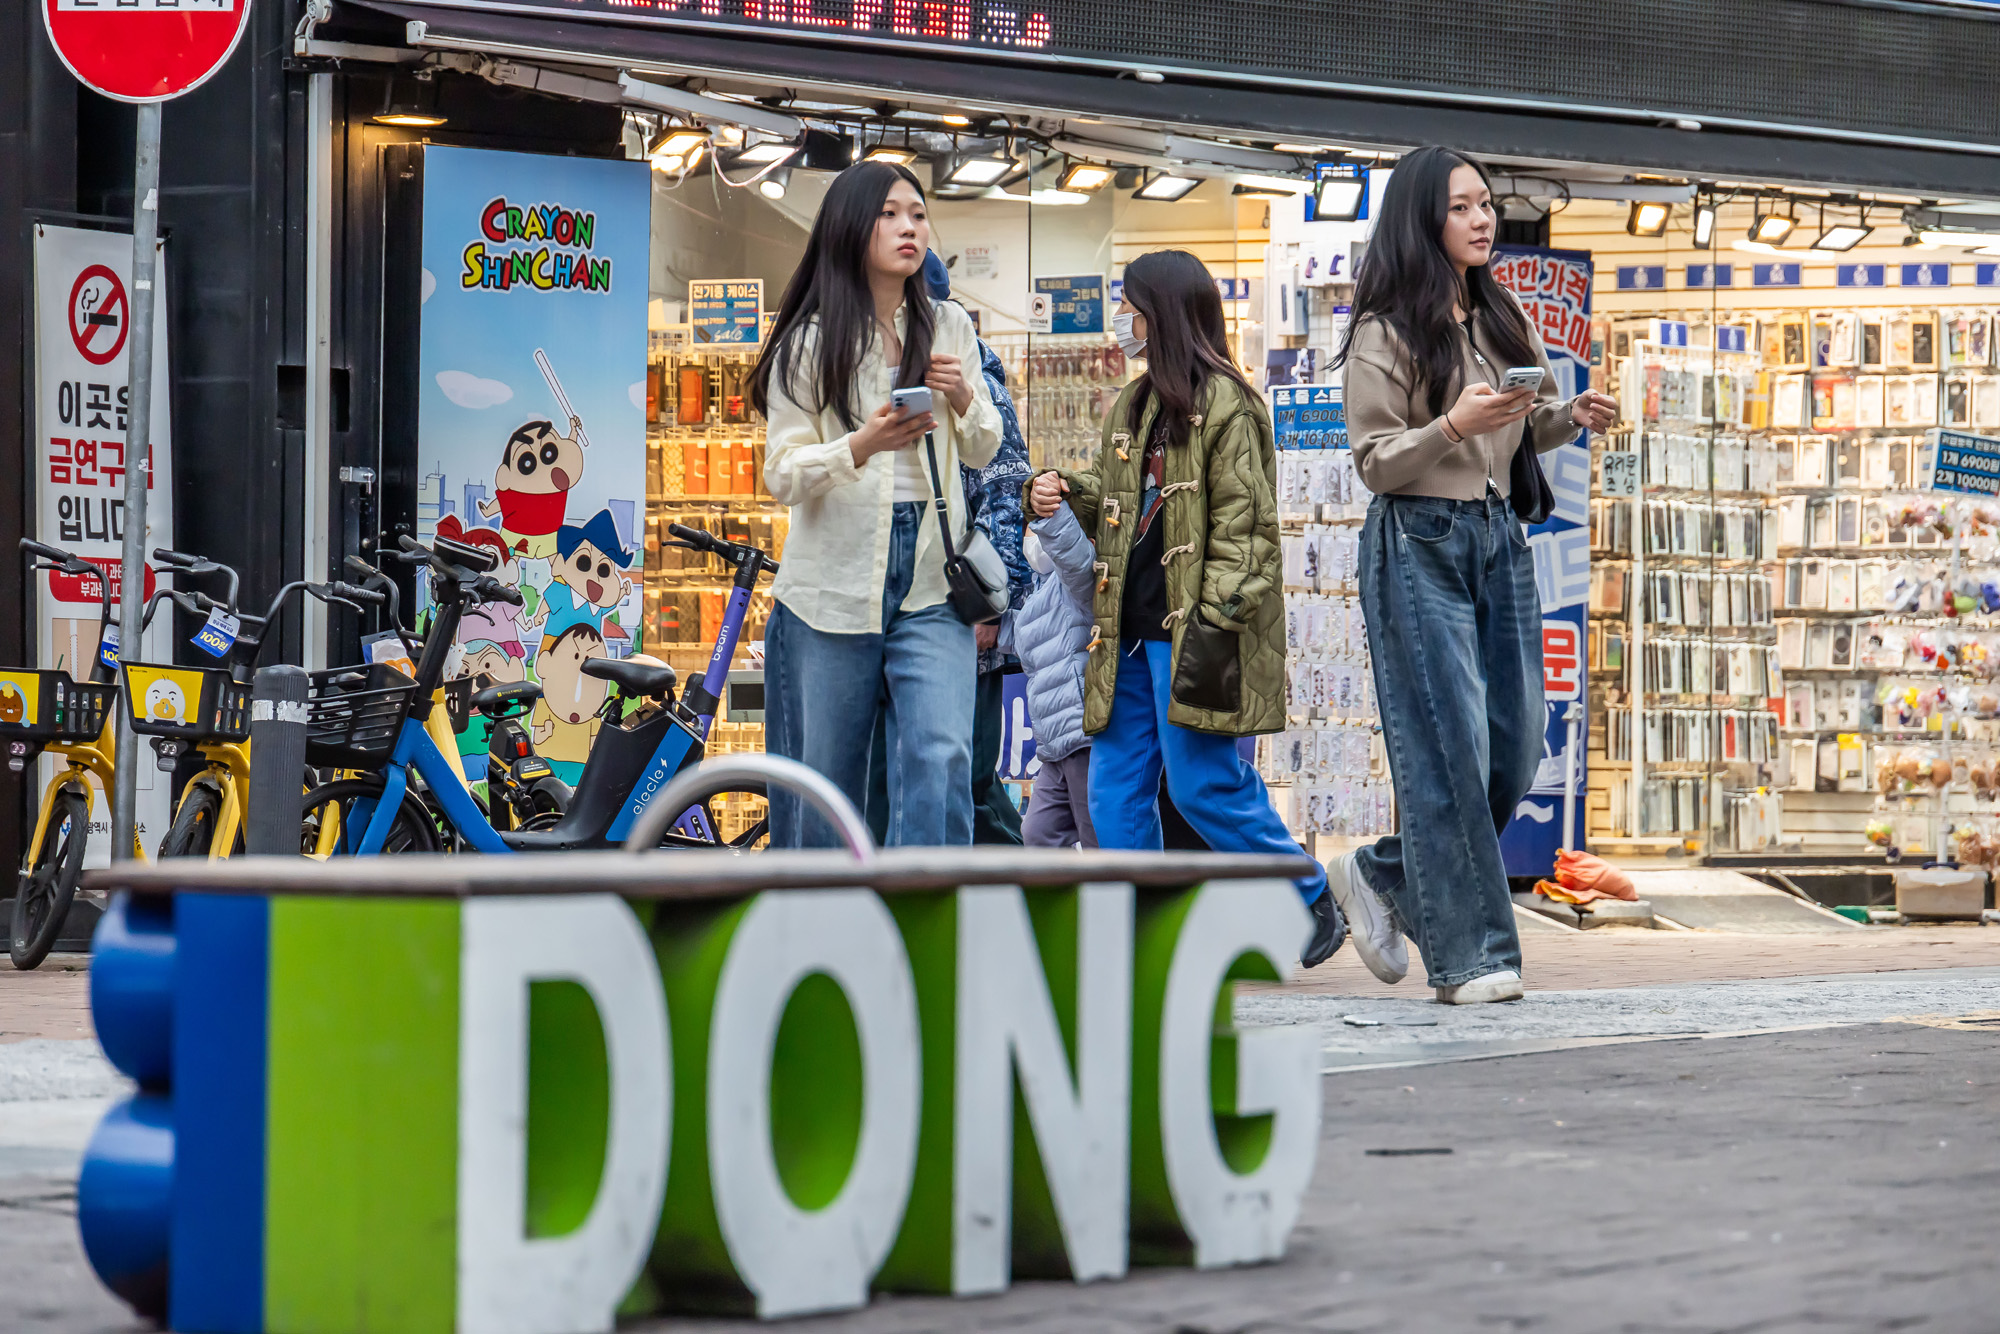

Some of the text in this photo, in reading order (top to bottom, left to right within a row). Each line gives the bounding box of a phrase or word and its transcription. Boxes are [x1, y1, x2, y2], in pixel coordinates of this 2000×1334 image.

[481, 198, 594, 249] CRAYON
[462, 242, 610, 292] SHINCHAN
[1543, 260, 1588, 308] 가격
[727, 284, 758, 298] 케이스
[49, 437, 154, 490] 금연구
[1936, 469, 1999, 493] 2개 10000원
[1942, 450, 1999, 473] 1개 6900원
[200, 631, 229, 651] 100원
[712, 625, 729, 661] beam
[633, 769, 664, 815] elecle
[456, 878, 1323, 1334] DONG
